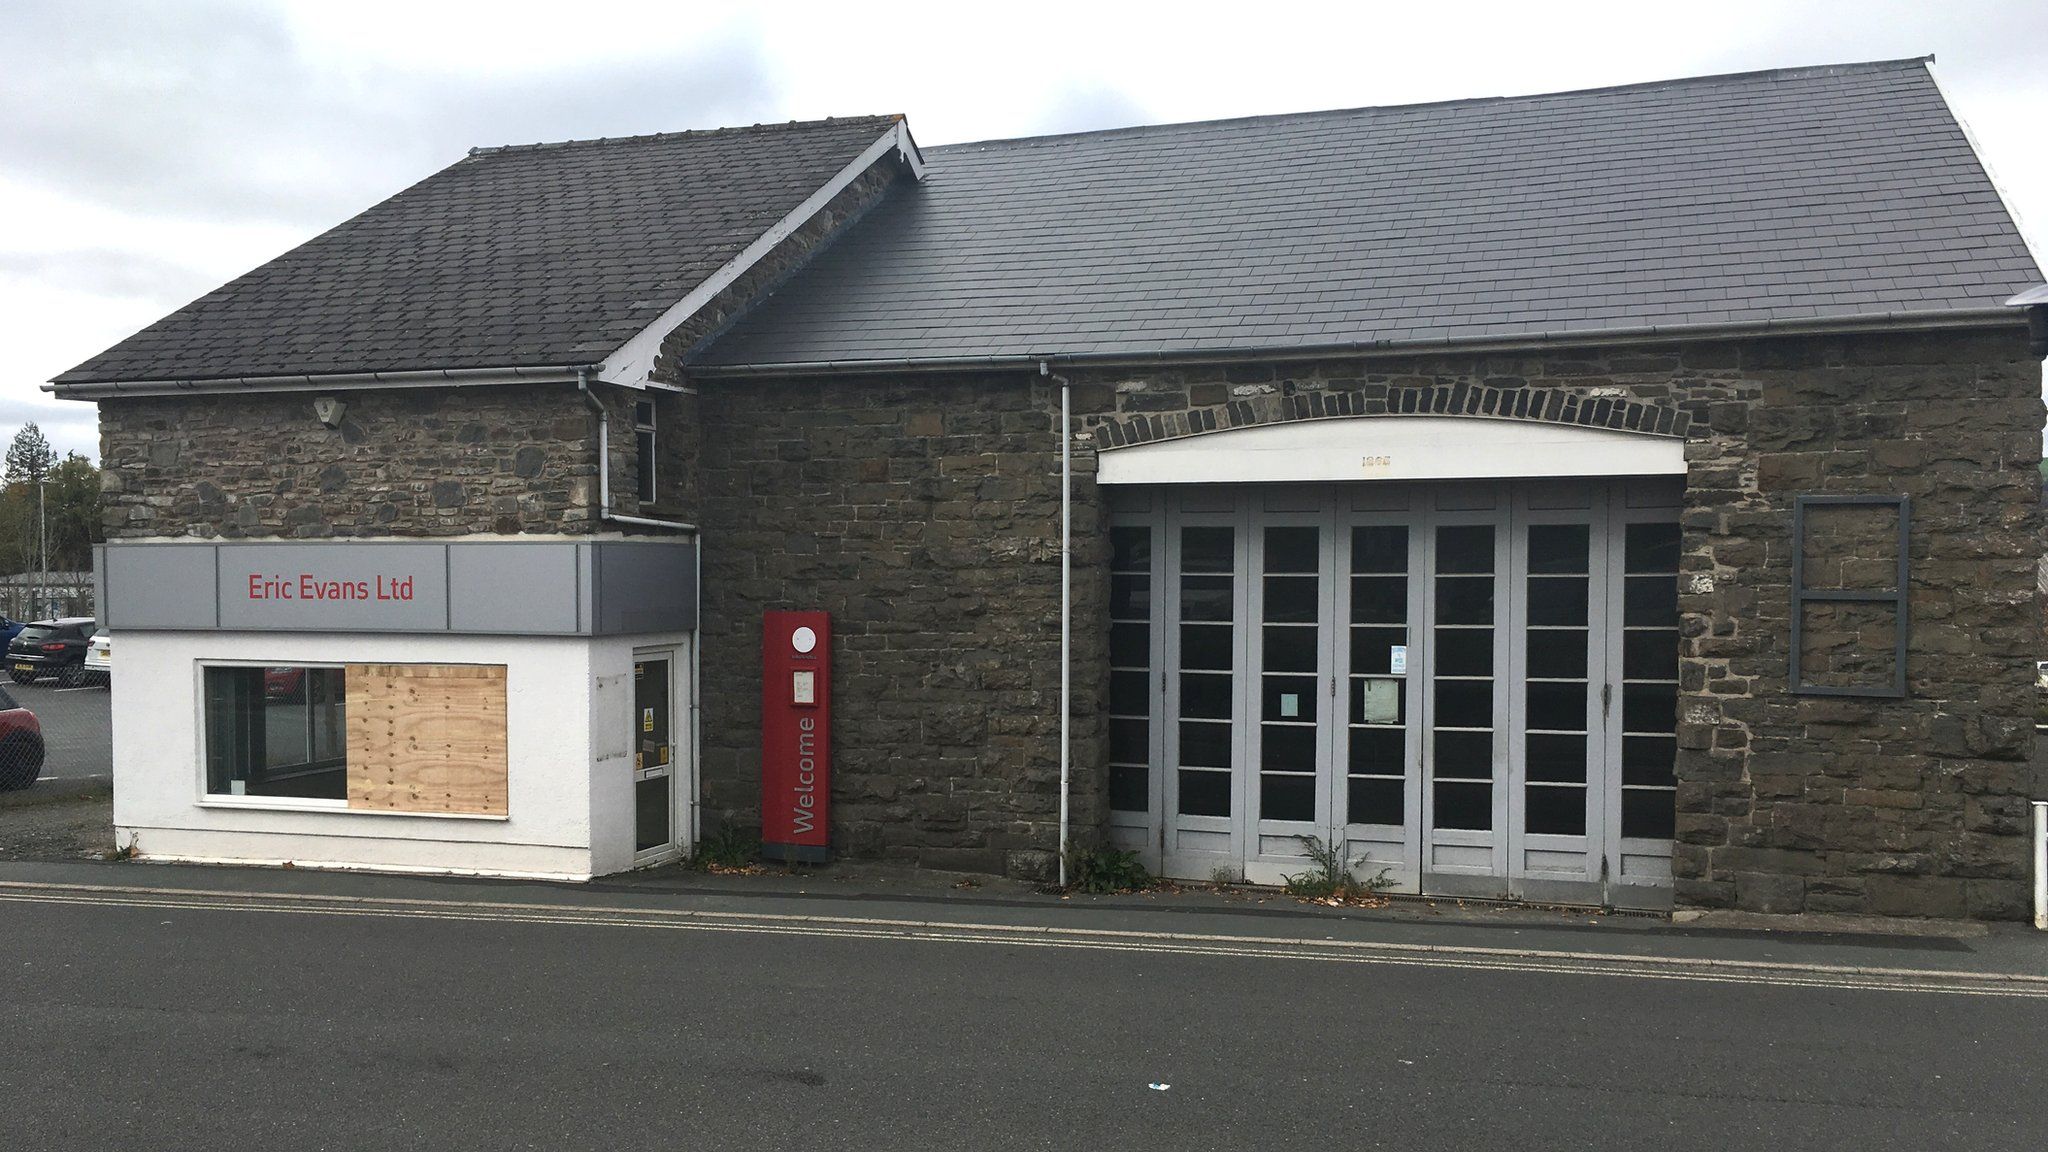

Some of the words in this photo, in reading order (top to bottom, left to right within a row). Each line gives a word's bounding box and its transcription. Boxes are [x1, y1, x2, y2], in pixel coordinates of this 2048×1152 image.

[249, 574, 292, 599] Eric
[300, 574, 369, 600] Evans
[376, 575, 413, 600] Ltd
[793, 717, 815, 834] Welcome
